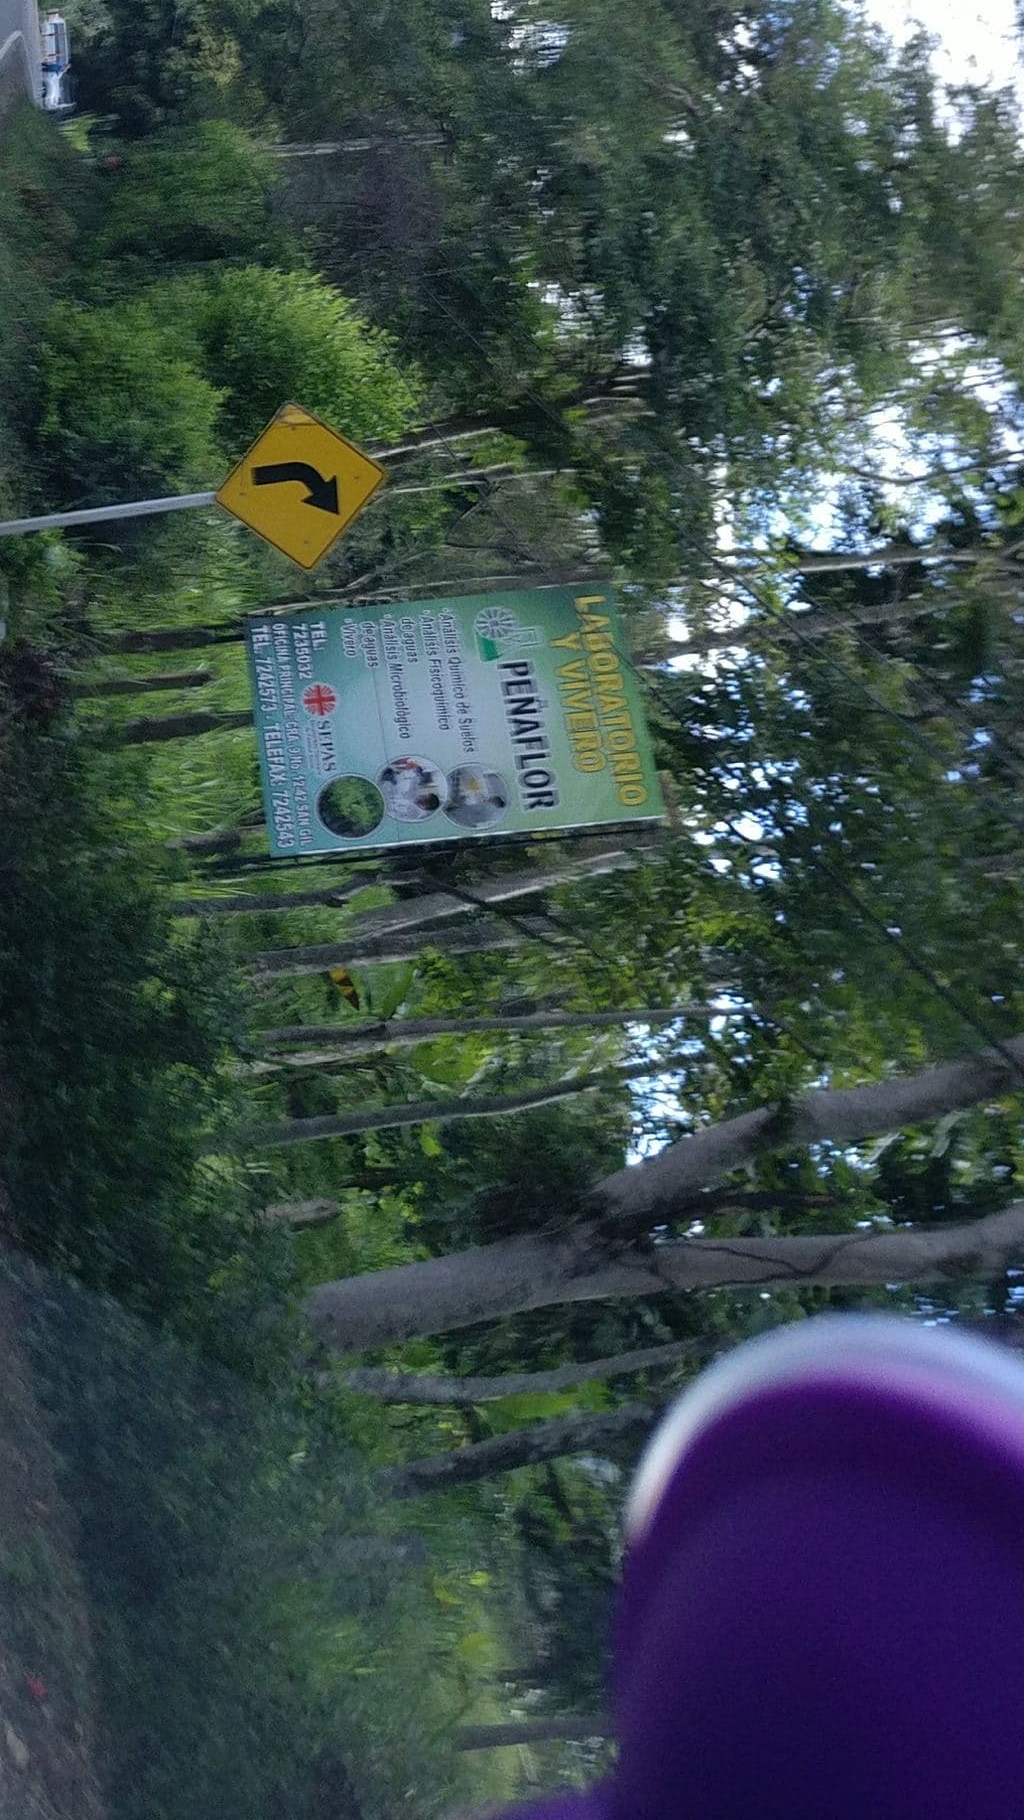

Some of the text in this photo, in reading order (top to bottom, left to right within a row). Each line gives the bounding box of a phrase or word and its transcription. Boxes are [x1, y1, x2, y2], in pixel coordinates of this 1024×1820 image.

[272, 623, 291, 662] OFICINA
[292, 623, 313, 679] 7235032
[340, 623, 356, 657] Vivero
[362, 636, 378, 668] aguas
[402, 633, 418, 663] aguas
[549, 631, 607, 773] Y VIVERO
[575, 595, 648, 806] LABORATORIO
[255, 657, 278, 712] 7242573
[271, 789, 294, 848] 7242543
[318, 719, 337, 772] SEPAS
[458, 717, 475, 753] Suelos
[497, 660, 560, 812] PEÑAFLOR
[296, 803, 310, 826] SAN
[299, 828, 314, 846] GIL
